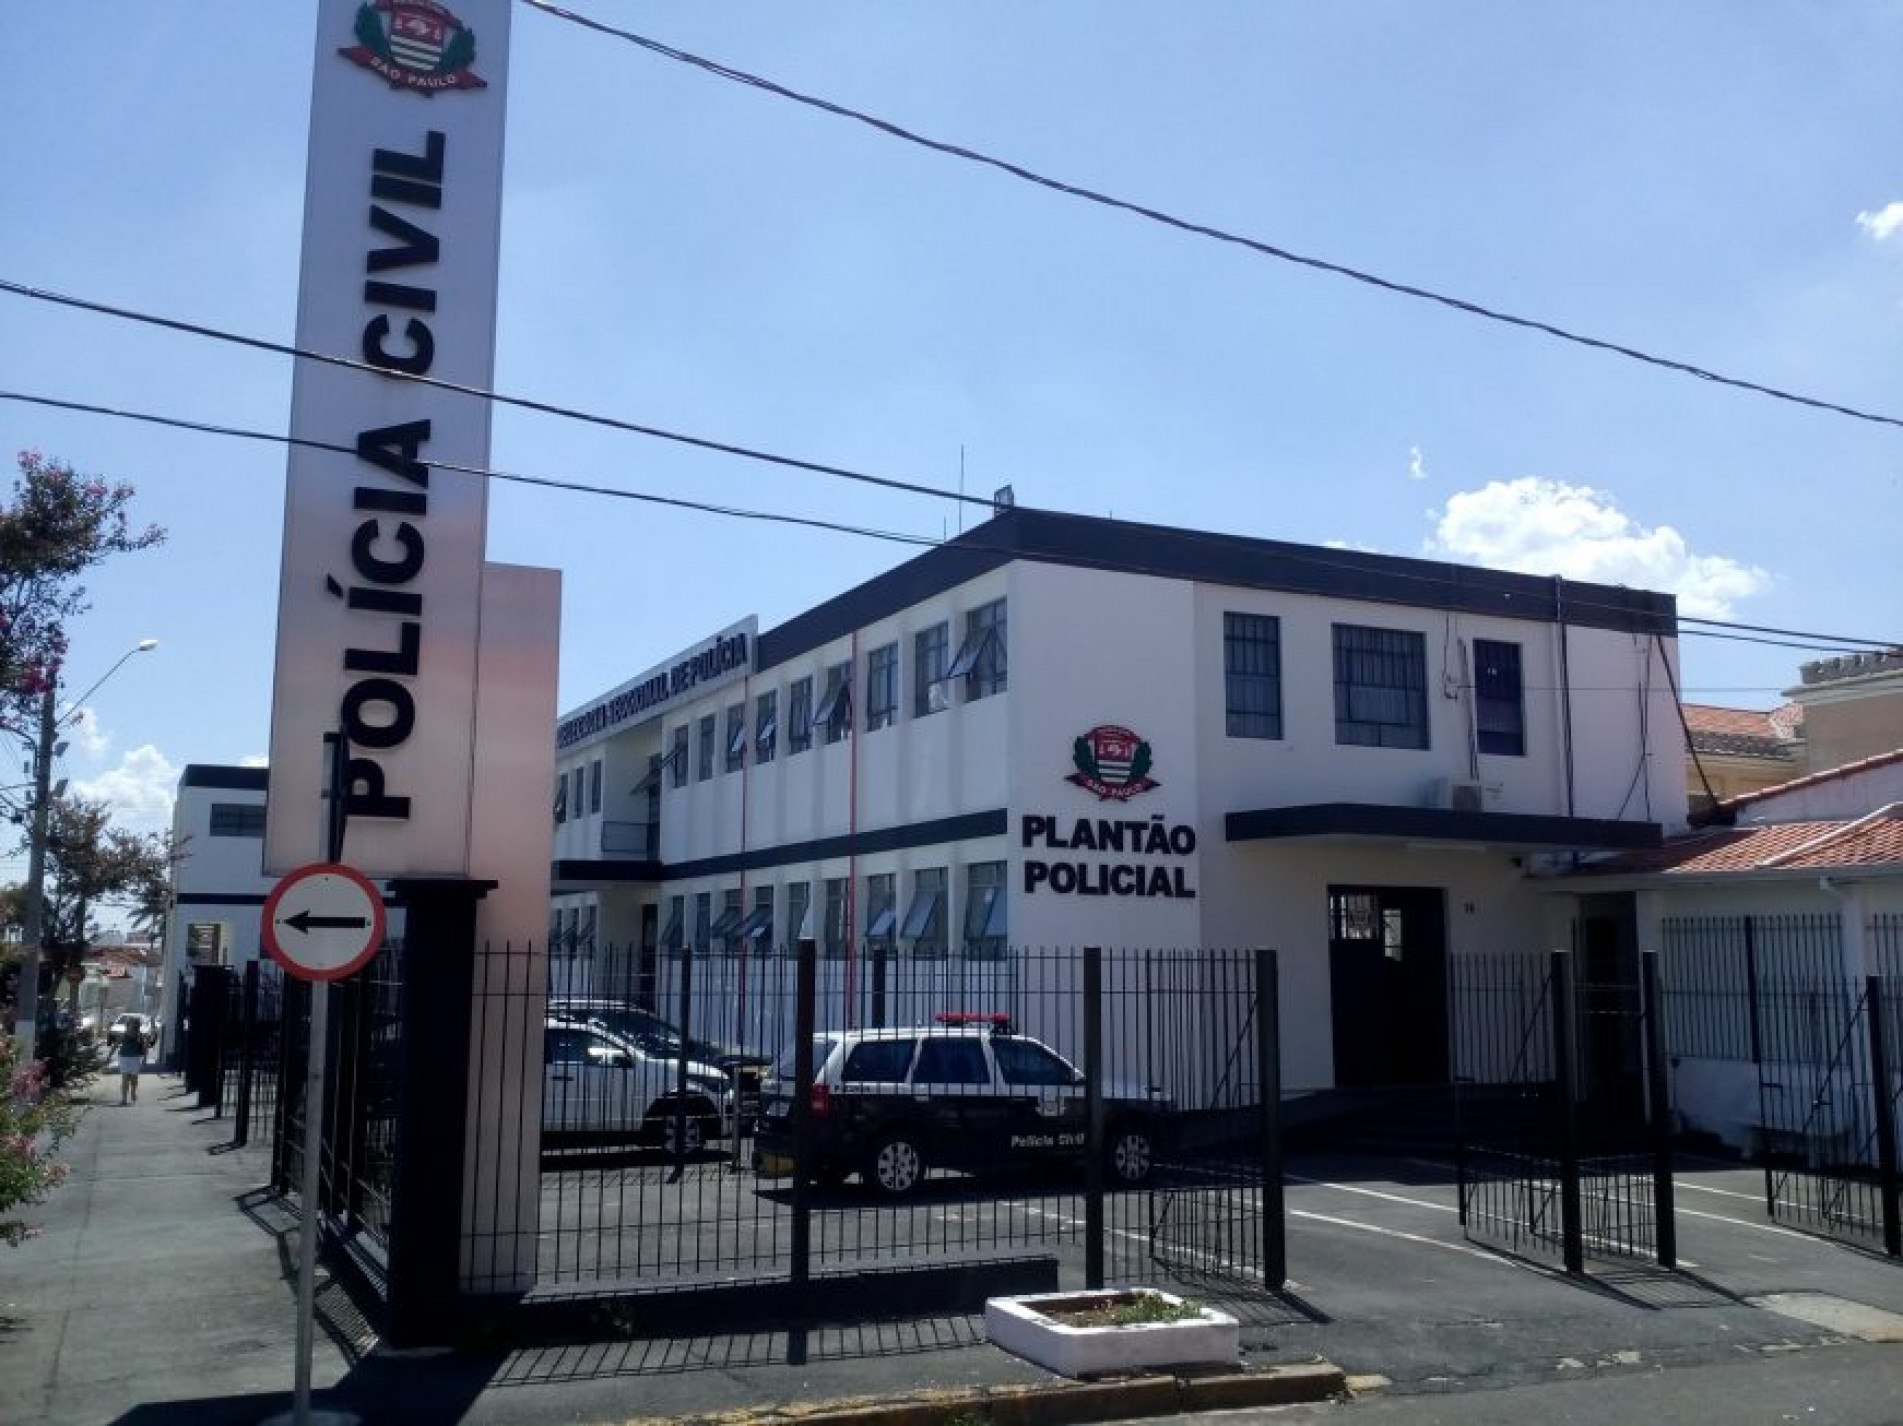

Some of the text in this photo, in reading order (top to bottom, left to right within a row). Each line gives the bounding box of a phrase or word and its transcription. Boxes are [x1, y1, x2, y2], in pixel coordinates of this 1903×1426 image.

[408, 74, 456, 88] PAULO
[327, 129, 446, 820] POLÍCIA CIVIL
[1022, 814, 1196, 856] PLANTÃO
[1024, 860, 1196, 898] POLICIAL
